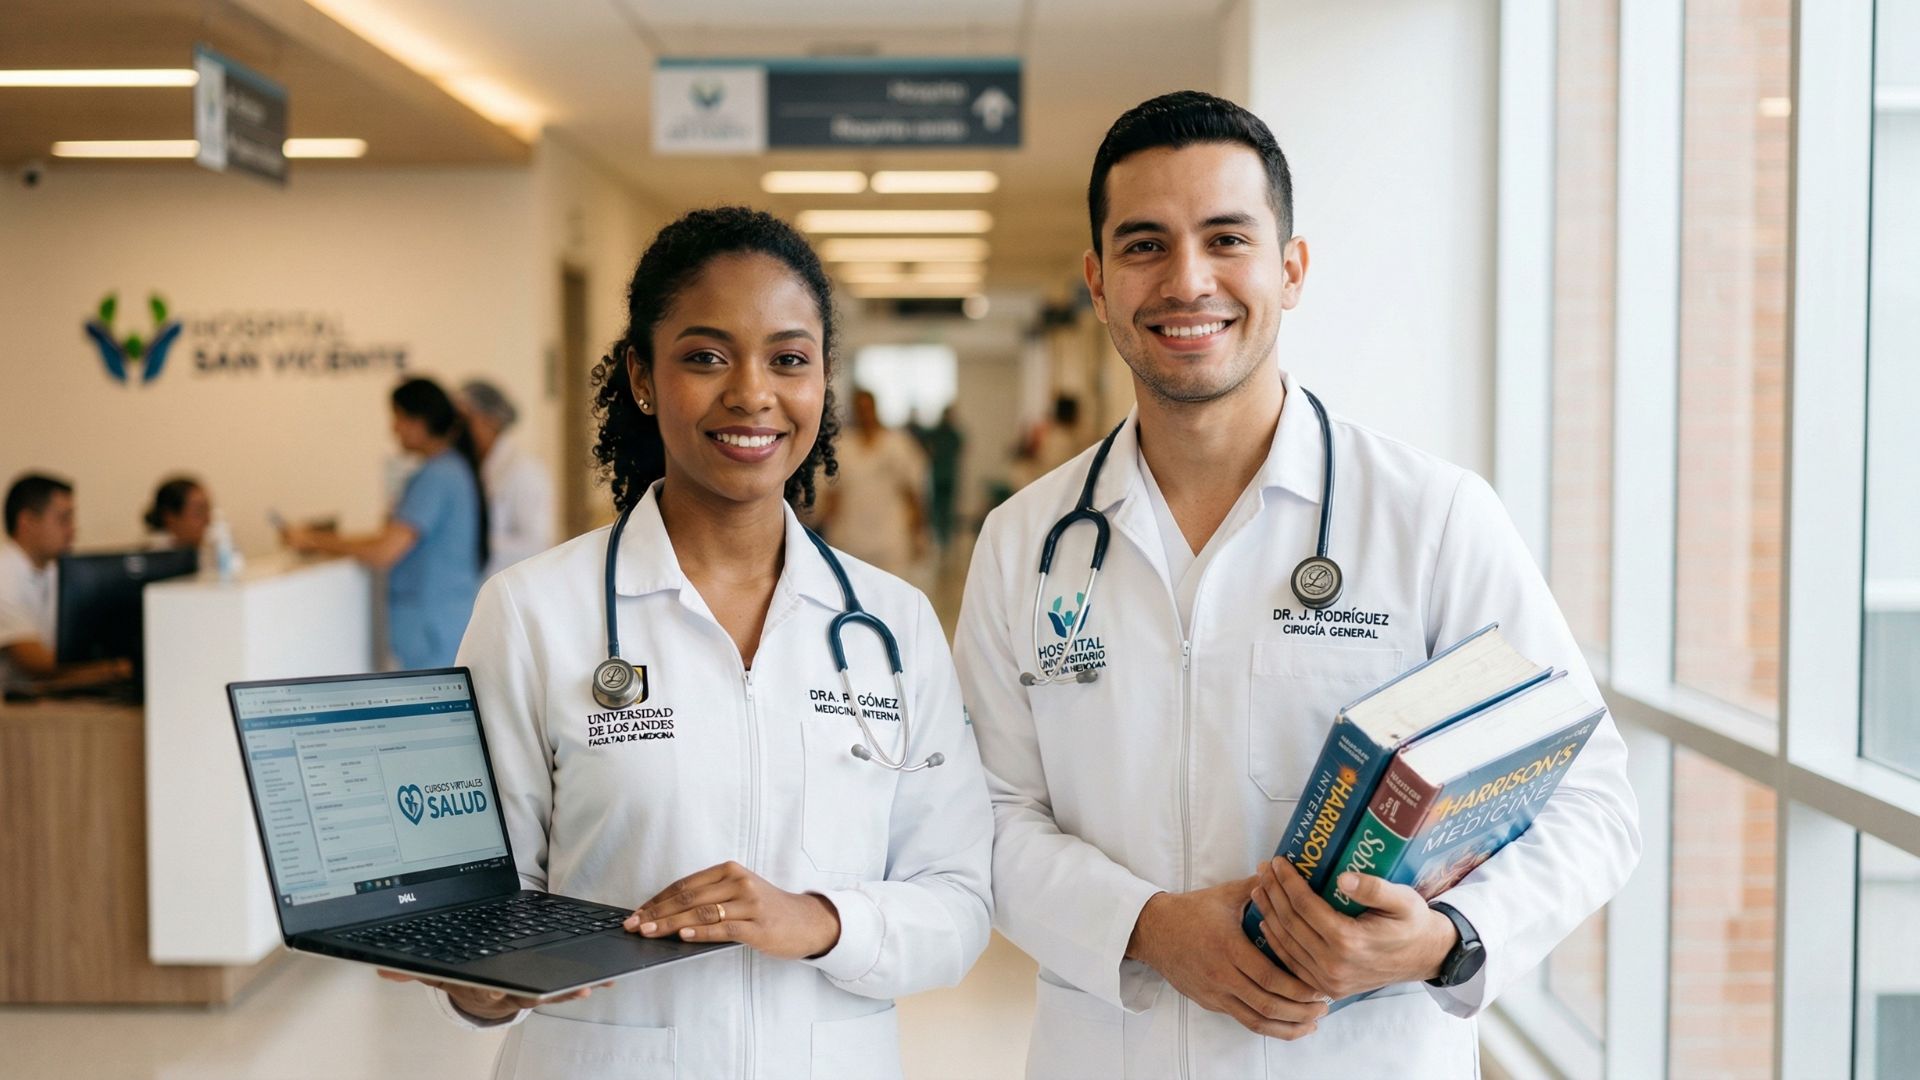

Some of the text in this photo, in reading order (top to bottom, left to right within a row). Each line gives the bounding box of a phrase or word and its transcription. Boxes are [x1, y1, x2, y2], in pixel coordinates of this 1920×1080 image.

[193, 344, 411, 374] SAN VICENTE
[1273, 607, 1390, 626] DR. J. RODRÍGUEZ
[1283, 622, 1379, 639] CIRUGÍA GENERAL
[1038, 636, 1105, 660] HOSITAL
[1040, 650, 1106, 670] UNIVRSITARIO
[810, 690, 840, 703] DRA.
[857, 692, 900, 710] GÓMEZ
[587, 707, 674, 725] UNIVERSIDAD
[862, 708, 901, 722] INTERNA
[588, 719, 675, 738] DE LOS ANDES
[588, 735, 626, 747] FACULTAD
[627, 733, 638, 742] DE
[424, 782, 450, 794] CURSOS
[1439, 743, 1577, 821] HARRISON'S
[427, 790, 487, 819] SALUD
[1421, 781, 1553, 854] MEDICINE
